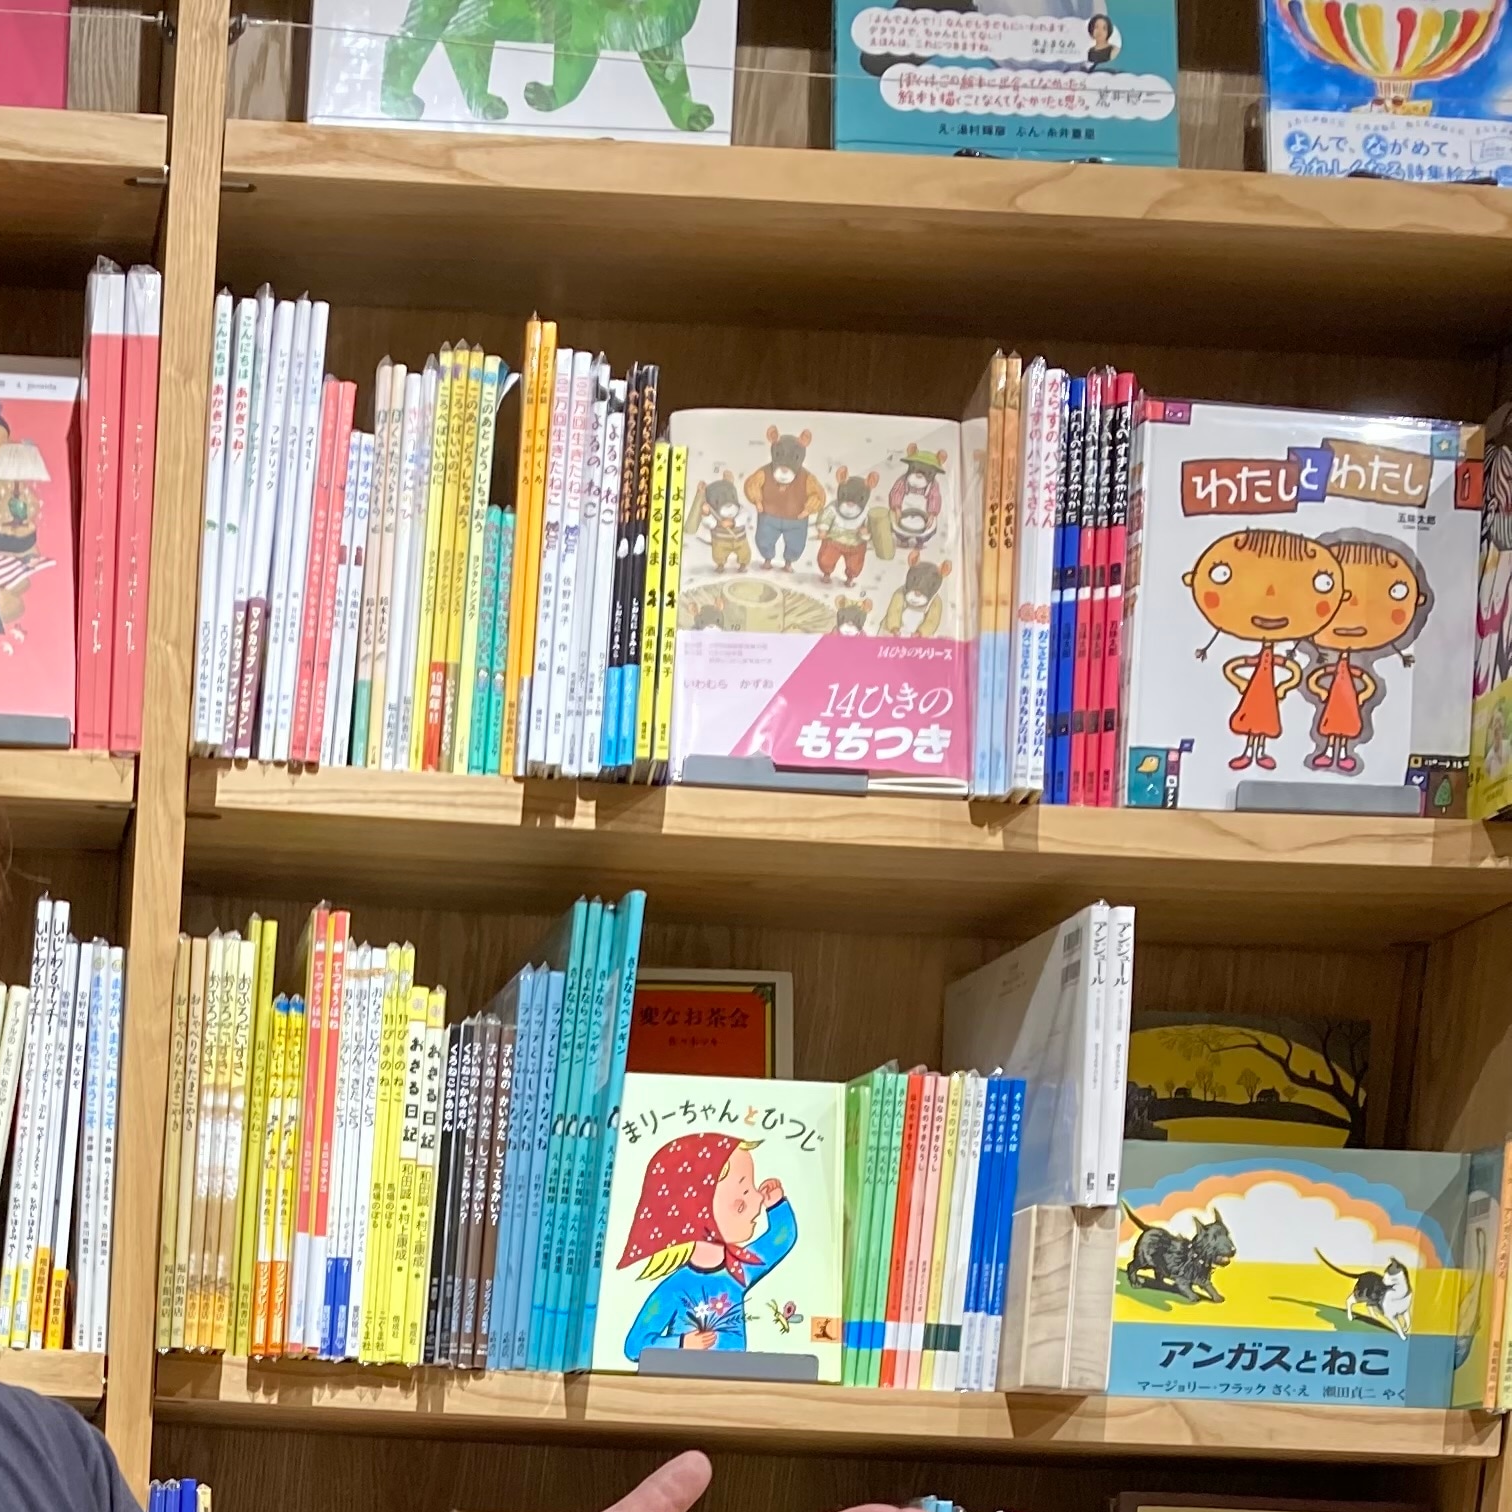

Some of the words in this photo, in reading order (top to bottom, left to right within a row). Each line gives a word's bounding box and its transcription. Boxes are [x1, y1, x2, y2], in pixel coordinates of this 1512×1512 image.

[214, 312, 229, 377] こんにちは
[237, 315, 254, 381] こんにちは
[432, 386, 450, 486] ころべばいいのに
[446, 385, 466, 486] ころべばいいのに
[482, 391, 495, 441] このあと
[1044, 378, 1060, 442] からすの
[358, 444, 376, 520] やすみのひ
[604, 421, 620, 478] よるの
[1192, 453, 1426, 509] わたしとわたし
[473, 446, 492, 533] どうしちゃおう
[601, 486, 619, 526] ねこ
[1041, 450, 1059, 529] パンやさん
[1397, 513, 1437, 527] 五味太郎
[648, 486, 665, 566] よるくま
[667, 487, 684, 567] よるくま
[987, 503, 1001, 549] やまいも
[1002, 502, 1016, 550] やまいも
[244, 606, 262, 671] マグカップ
[877, 646, 953, 661] 14ひきのシリーズ
[236, 673, 255, 740] プレゼント
[683, 679, 728, 691] いわむら
[820, 681, 954, 720] 14ひきの
[795, 720, 953, 764] もちつき
[29, 917, 49, 1036] いじわるブッチー
[45, 917, 65, 1036] いじわるブッチー
[1091, 920, 1107, 987] アンジュール
[1113, 920, 1133, 987] アンジュール
[202, 970, 221, 1076] おふろだいすき
[217, 970, 236, 1076] おふろだいすき
[232, 971, 252, 1078] おふろだいすき
[329, 961, 344, 1032] てつぞうはね
[560, 966, 578, 1066] さよならペンギン
[574, 967, 592, 1066] さよならペンギン
[617, 956, 636, 1056] さよならペンギン
[72, 1042, 83, 1090] なぞなぞ
[171, 993, 187, 1132] おしゃべりなたまごやき
[184, 993, 201, 1132] おしゃべりなたまごやき
[379, 1013, 395, 1103] 11ぴきのねこ
[393, 1013, 409, 1103] 11ぴきのねこ
[402, 1037, 424, 1142] おさる日記
[443, 1043, 459, 1133] くろねこかあさん
[456, 1042, 473, 1131] くろねこかあさん
[469, 1042, 483, 1089] 子いぬの
[484, 1043, 498, 1090] 子いぬの
[500, 1043, 514, 1090] 子いぬの
[104, 1075, 118, 1131] ようこそ
[420, 1043, 441, 1149] おさる日記
[465, 1094, 479, 1140] かいかた
[479, 1095, 494, 1140] かいかた
[496, 1095, 510, 1142] かいかた
[622, 1097, 825, 1152] まりーちゃんとひつじ
[918, 1094, 931, 1172] はなのすきなうし
[931, 1094, 945, 1173] はなのすきなうし
[399, 1163, 413, 1200] 和田誠
[416, 1170, 432, 1208] 和田誠
[459, 1144, 474, 1225] しってるかい？
[473, 1144, 488, 1226] しってるかい？
[394, 1213, 411, 1262] 村上康成
[412, 1219, 428, 1269] 村上康成
[1137, 1378, 1269, 1396] マージョリー・フラック
[1322, 1385, 1376, 1399] 瀬田貞二
[1382, 1389, 1407, 1401] やく
[1158, 1340, 1390, 1376] アンガスとねこ
